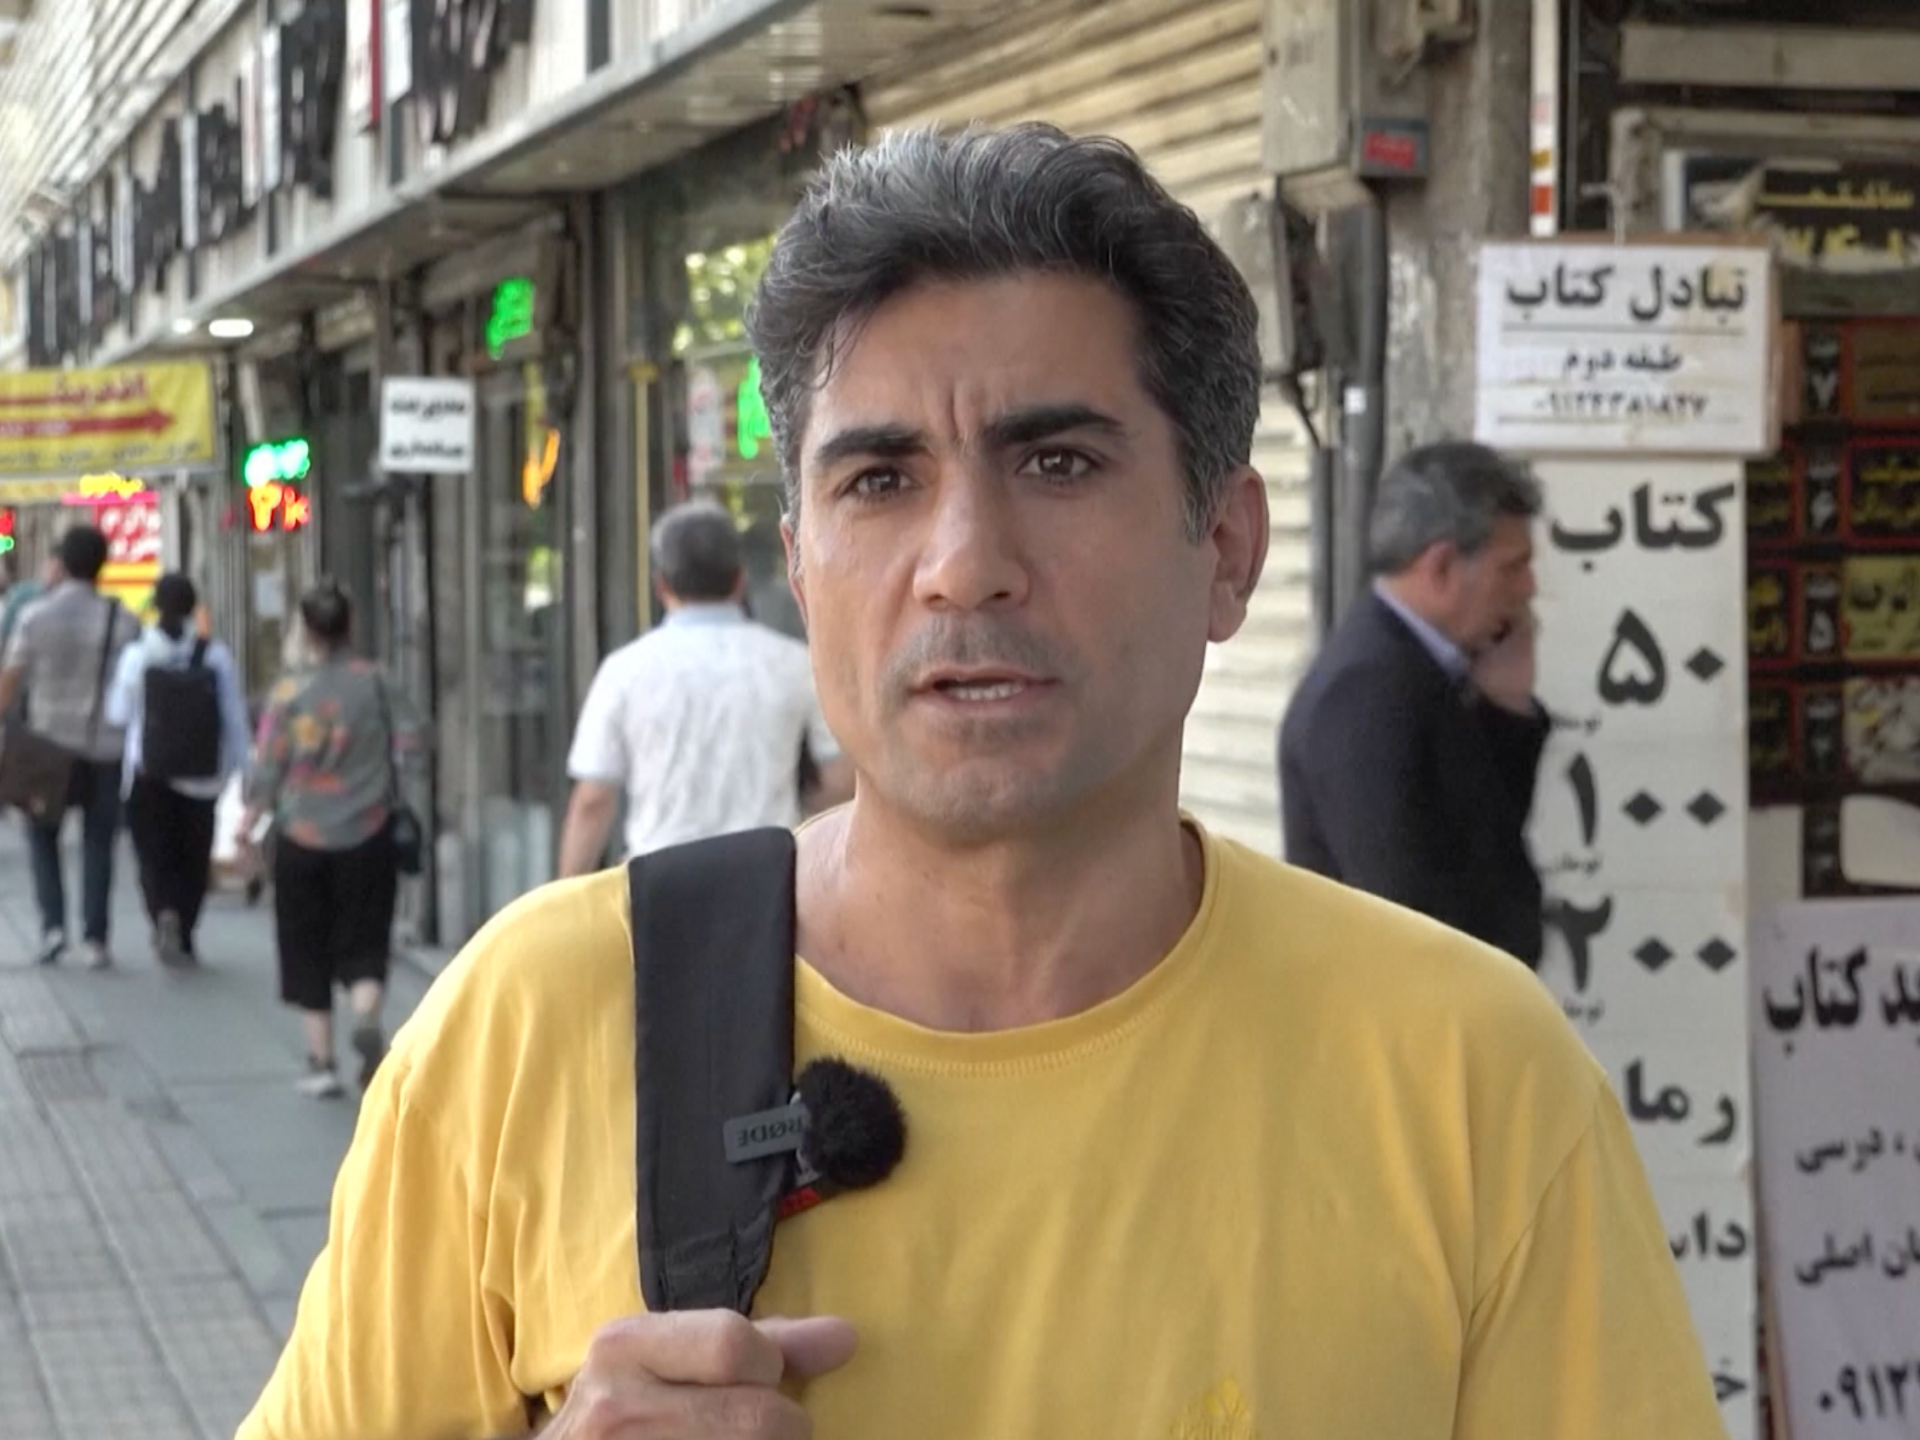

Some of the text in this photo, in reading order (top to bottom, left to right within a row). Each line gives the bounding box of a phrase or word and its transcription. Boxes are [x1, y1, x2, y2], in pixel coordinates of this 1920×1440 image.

[1506, 264, 1746, 325] تبادل کتاب
[1561, 349, 1616, 382] دوم
[1550, 482, 1735, 574] کتاب
[1596, 606, 1726, 708] ۵۰
[1566, 750, 1727, 848] ۱۰۰
[1542, 896, 1738, 995] ۲۰۰
[1764, 945, 1868, 1058] کتاب
[735, 1114, 802, 1149] RØDE
[1796, 1126, 1883, 1174] درسی
[1796, 1230, 1872, 1286] اصلی
